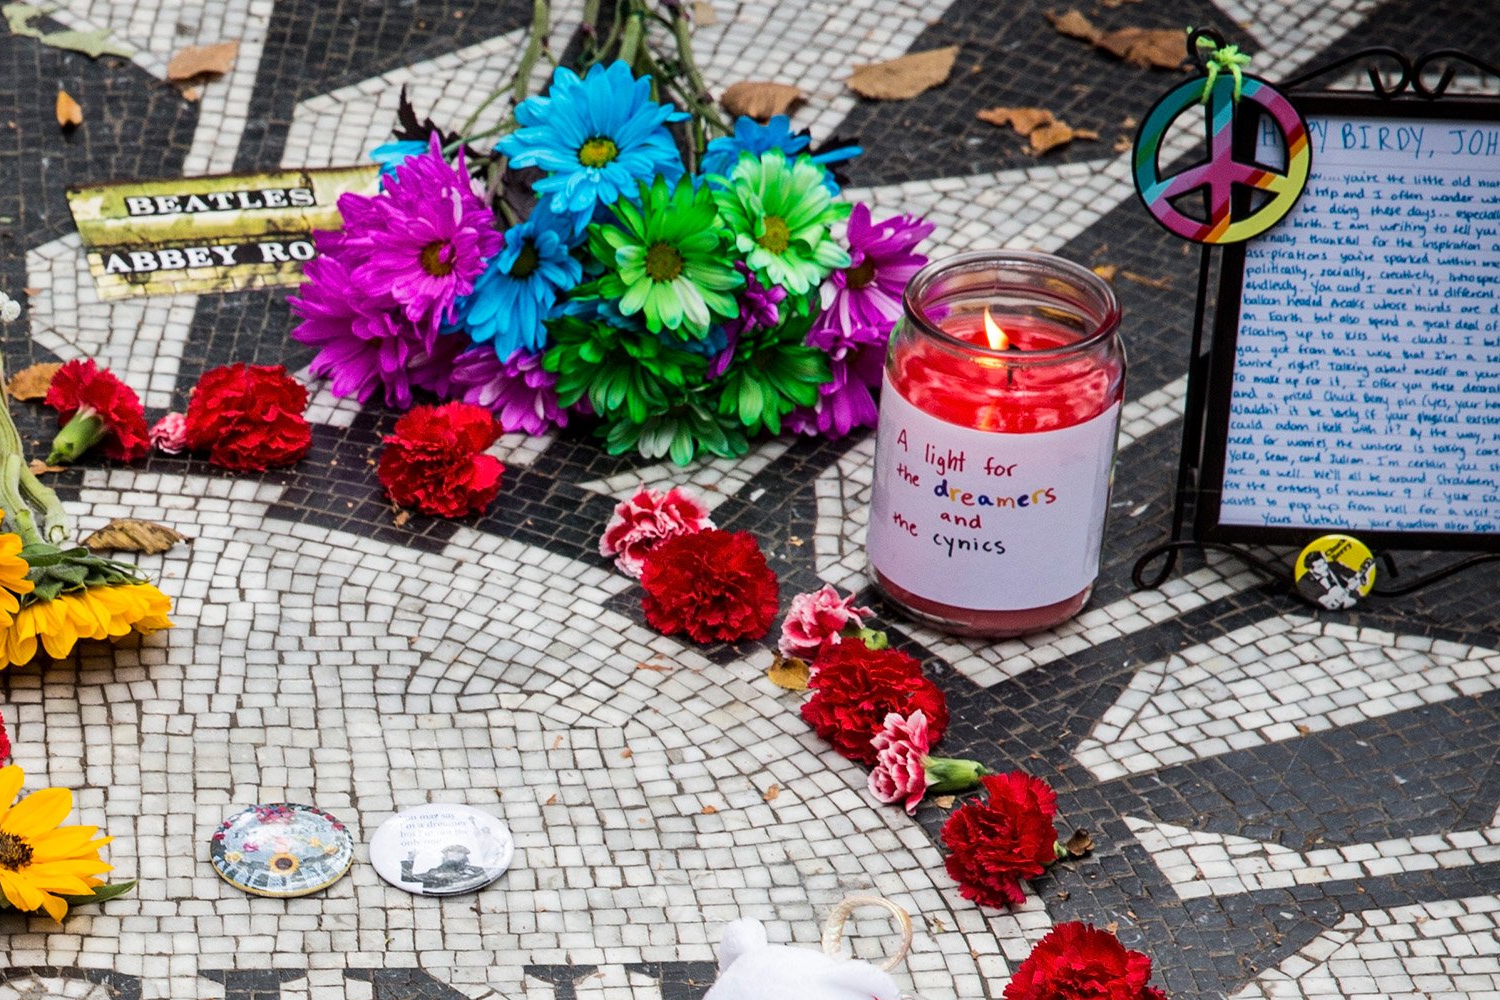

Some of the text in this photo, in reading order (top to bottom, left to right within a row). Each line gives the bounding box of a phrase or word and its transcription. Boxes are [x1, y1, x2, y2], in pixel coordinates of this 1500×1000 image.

[1341, 122, 1434, 158] BIRDY,
[1386, 174, 1406, 185] the
[1414, 174, 1445, 187] little
[1451, 174, 1471, 187] old
[127, 188, 316, 215] BEATLES
[1343, 187, 1365, 199] and
[1430, 191, 1474, 203] wonder
[1329, 204, 1360, 221] doing
[1380, 221, 1427, 238] writing
[1433, 223, 1448, 234] to
[1475, 227, 1497, 239] you
[1372, 235, 1389, 247] for
[1396, 236, 1413, 248] the
[104, 244, 239, 274] ABBEY
[1320, 329, 1335, 340] to
[896, 428, 1018, 477] A light for
[896, 462, 1057, 509] the dreamers
[940, 511, 982, 529] and
[893, 511, 1006, 558] the cynics
